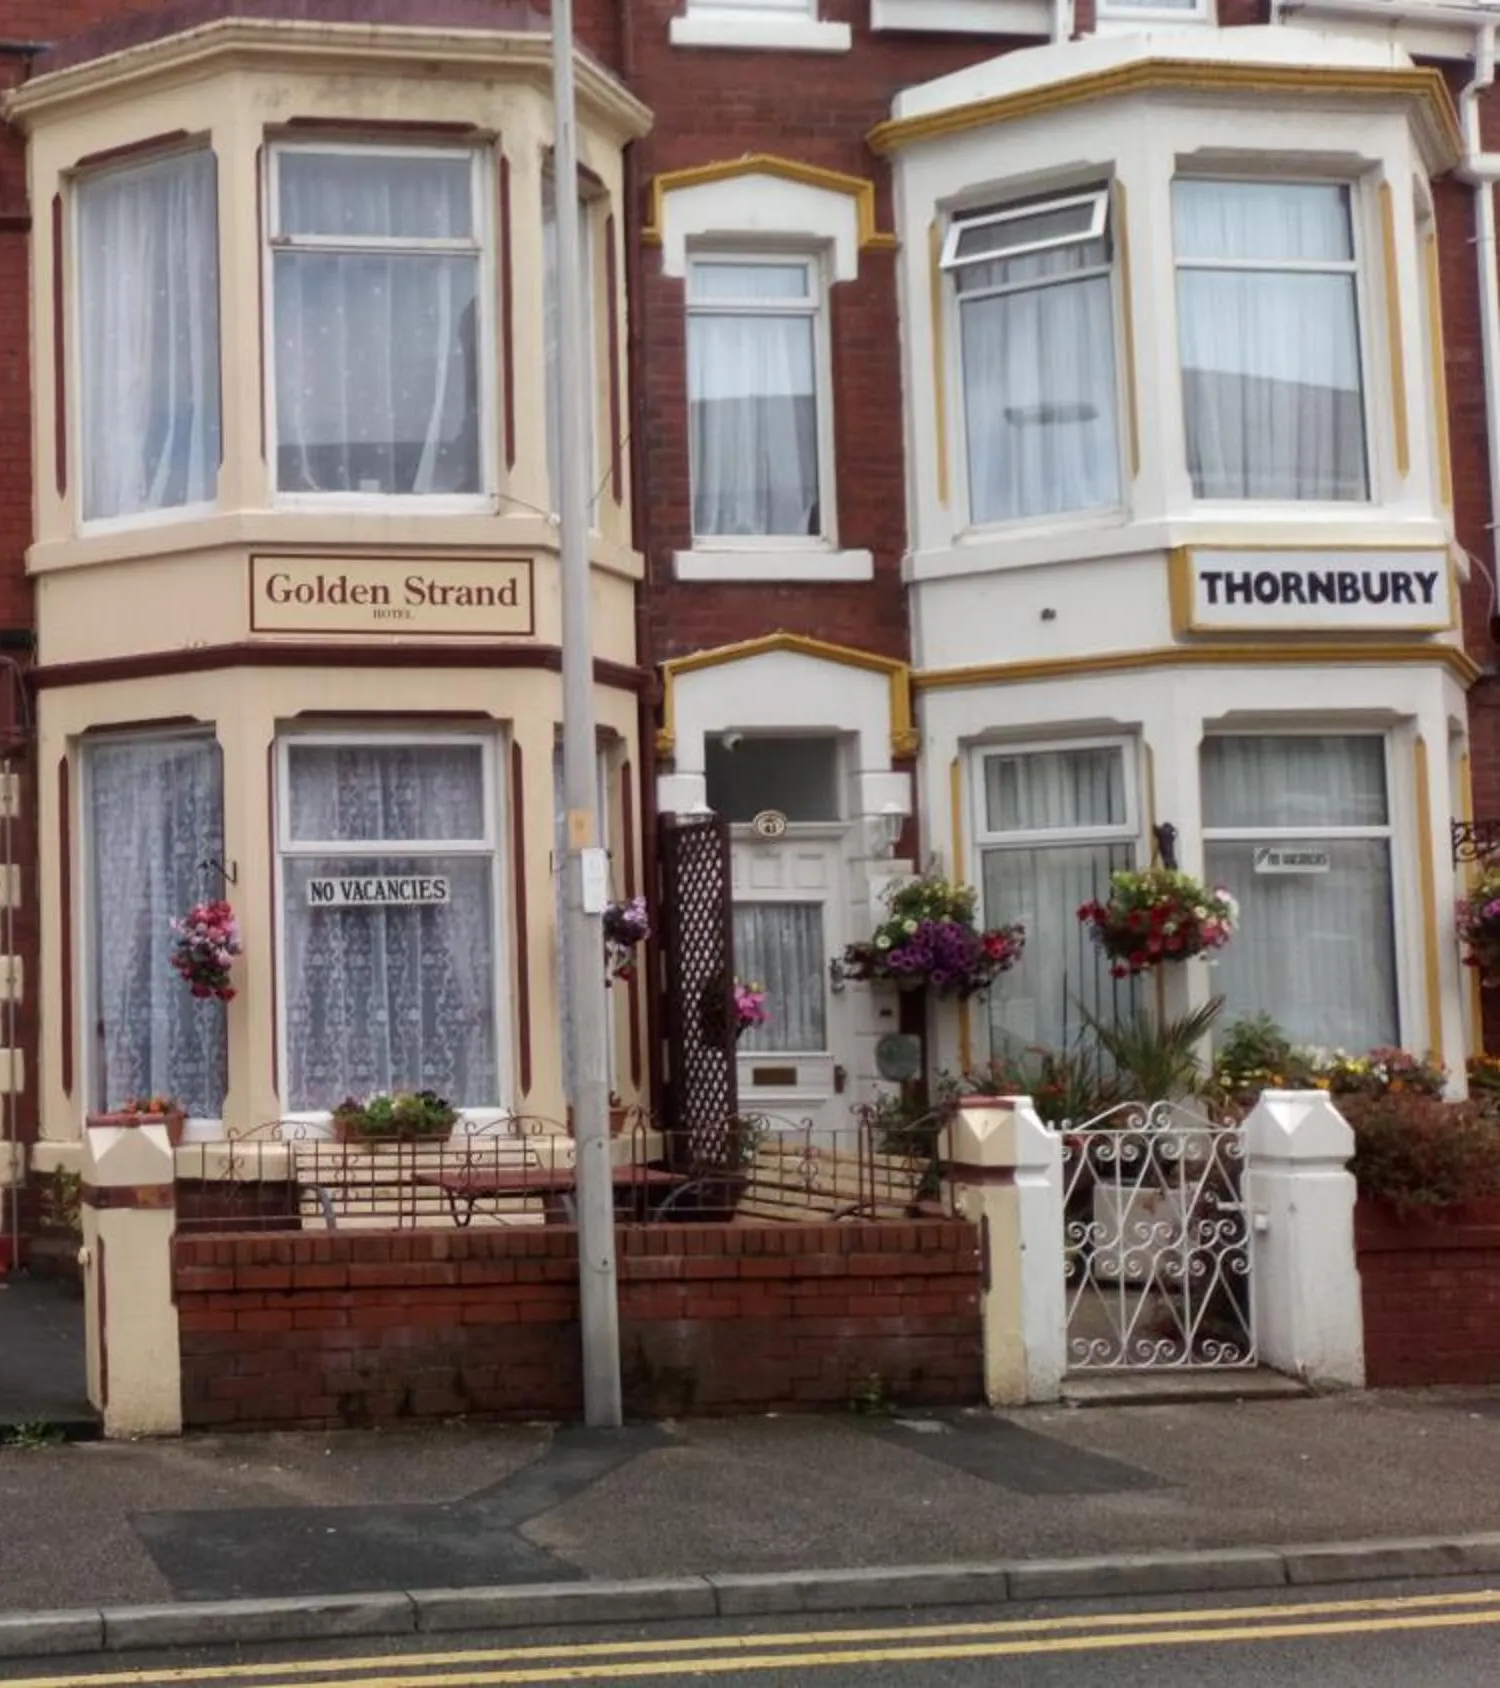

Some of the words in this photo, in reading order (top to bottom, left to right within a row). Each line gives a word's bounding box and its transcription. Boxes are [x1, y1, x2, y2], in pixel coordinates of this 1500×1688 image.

[265, 573, 391, 605] Golden
[403, 575, 519, 607] Strand
[1200, 571, 1439, 604] THORNBURY
[372, 608, 414, 620] HOTEL
[310, 881, 335, 902] NO
[340, 879, 447, 901] VACANCIES
